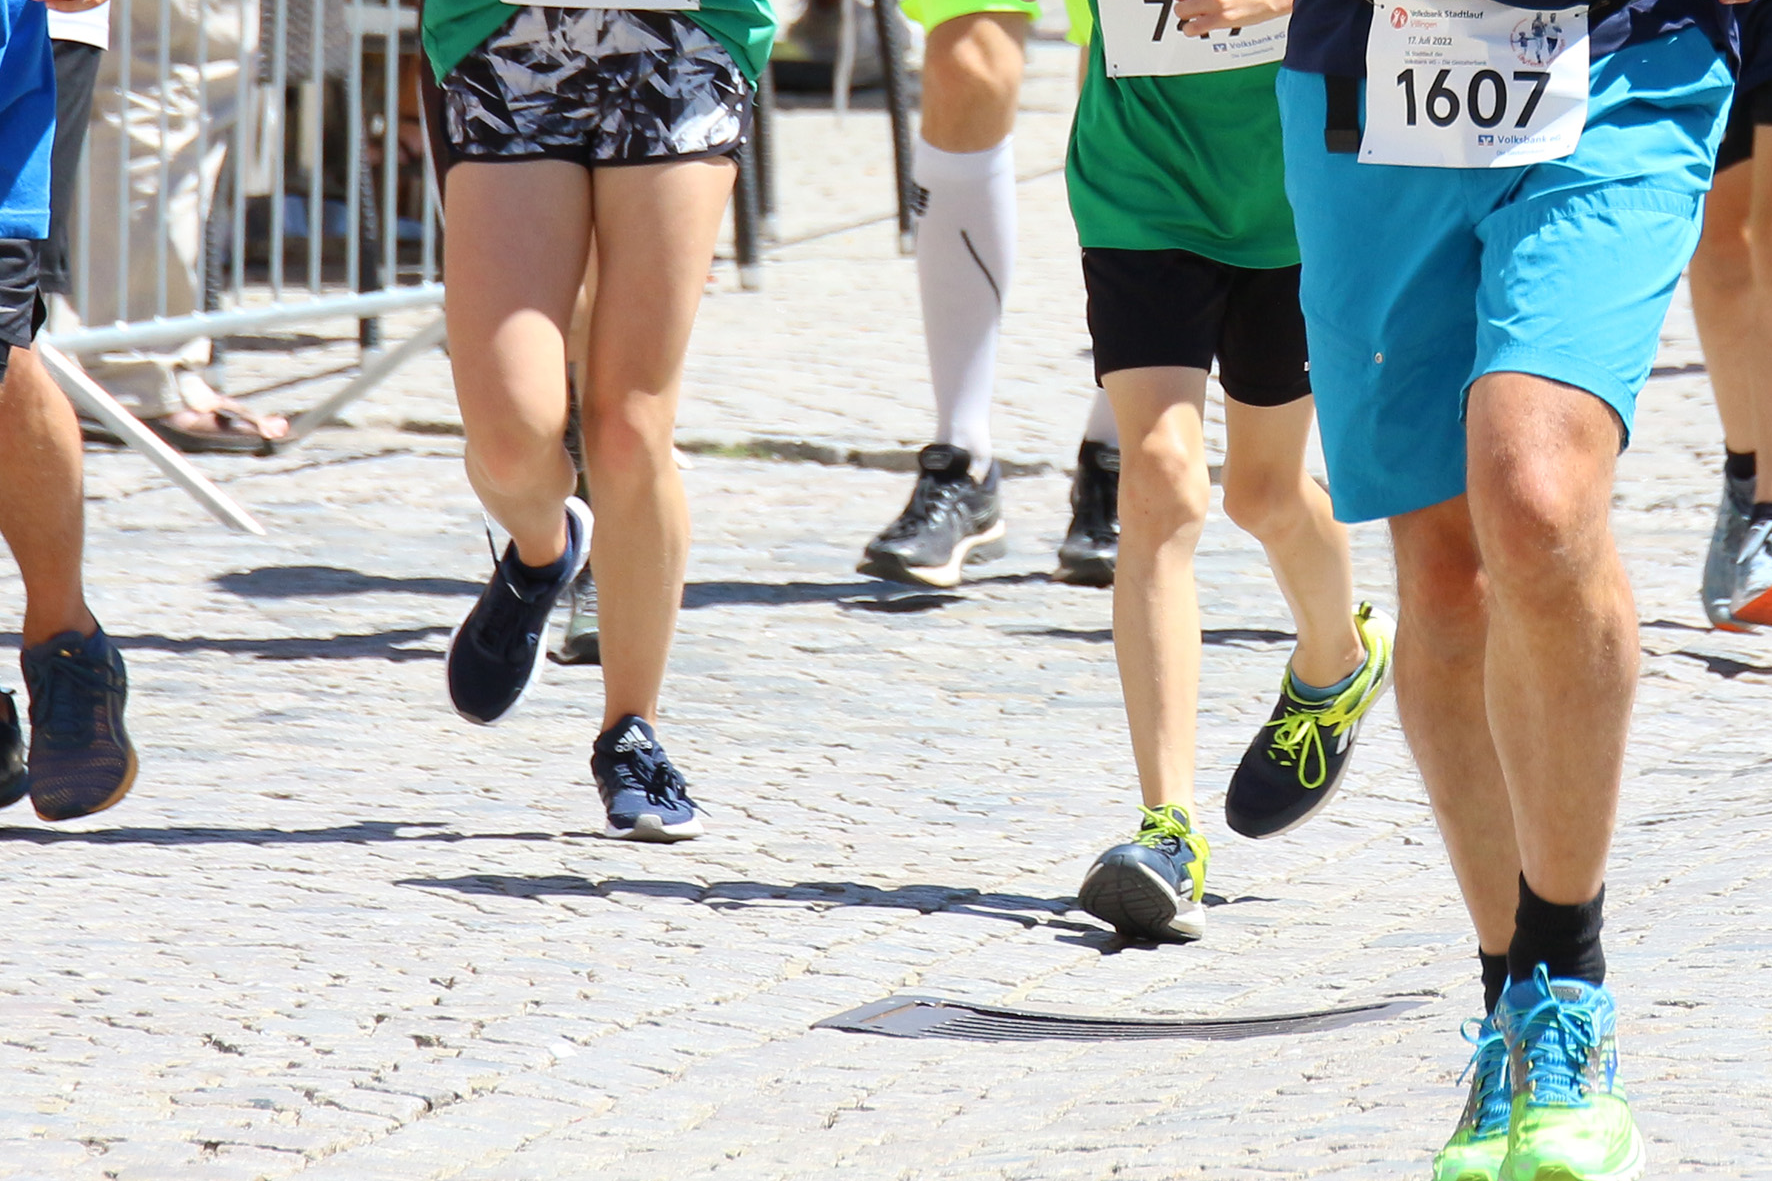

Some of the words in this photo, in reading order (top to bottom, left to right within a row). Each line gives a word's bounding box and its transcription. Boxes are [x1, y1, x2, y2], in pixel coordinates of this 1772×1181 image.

[1410, 9, 1442, 18] Volksbank
[1444, 10, 1484, 19] Stadtlauf
[1229, 34, 1273, 50] Volksbank
[1408, 36, 1417, 45] 17.
[1418, 35, 1430, 45] Juli
[1432, 36, 1453, 46] 2022
[1396, 68, 1551, 129] 1607
[1498, 135, 1546, 144] Volksbank
